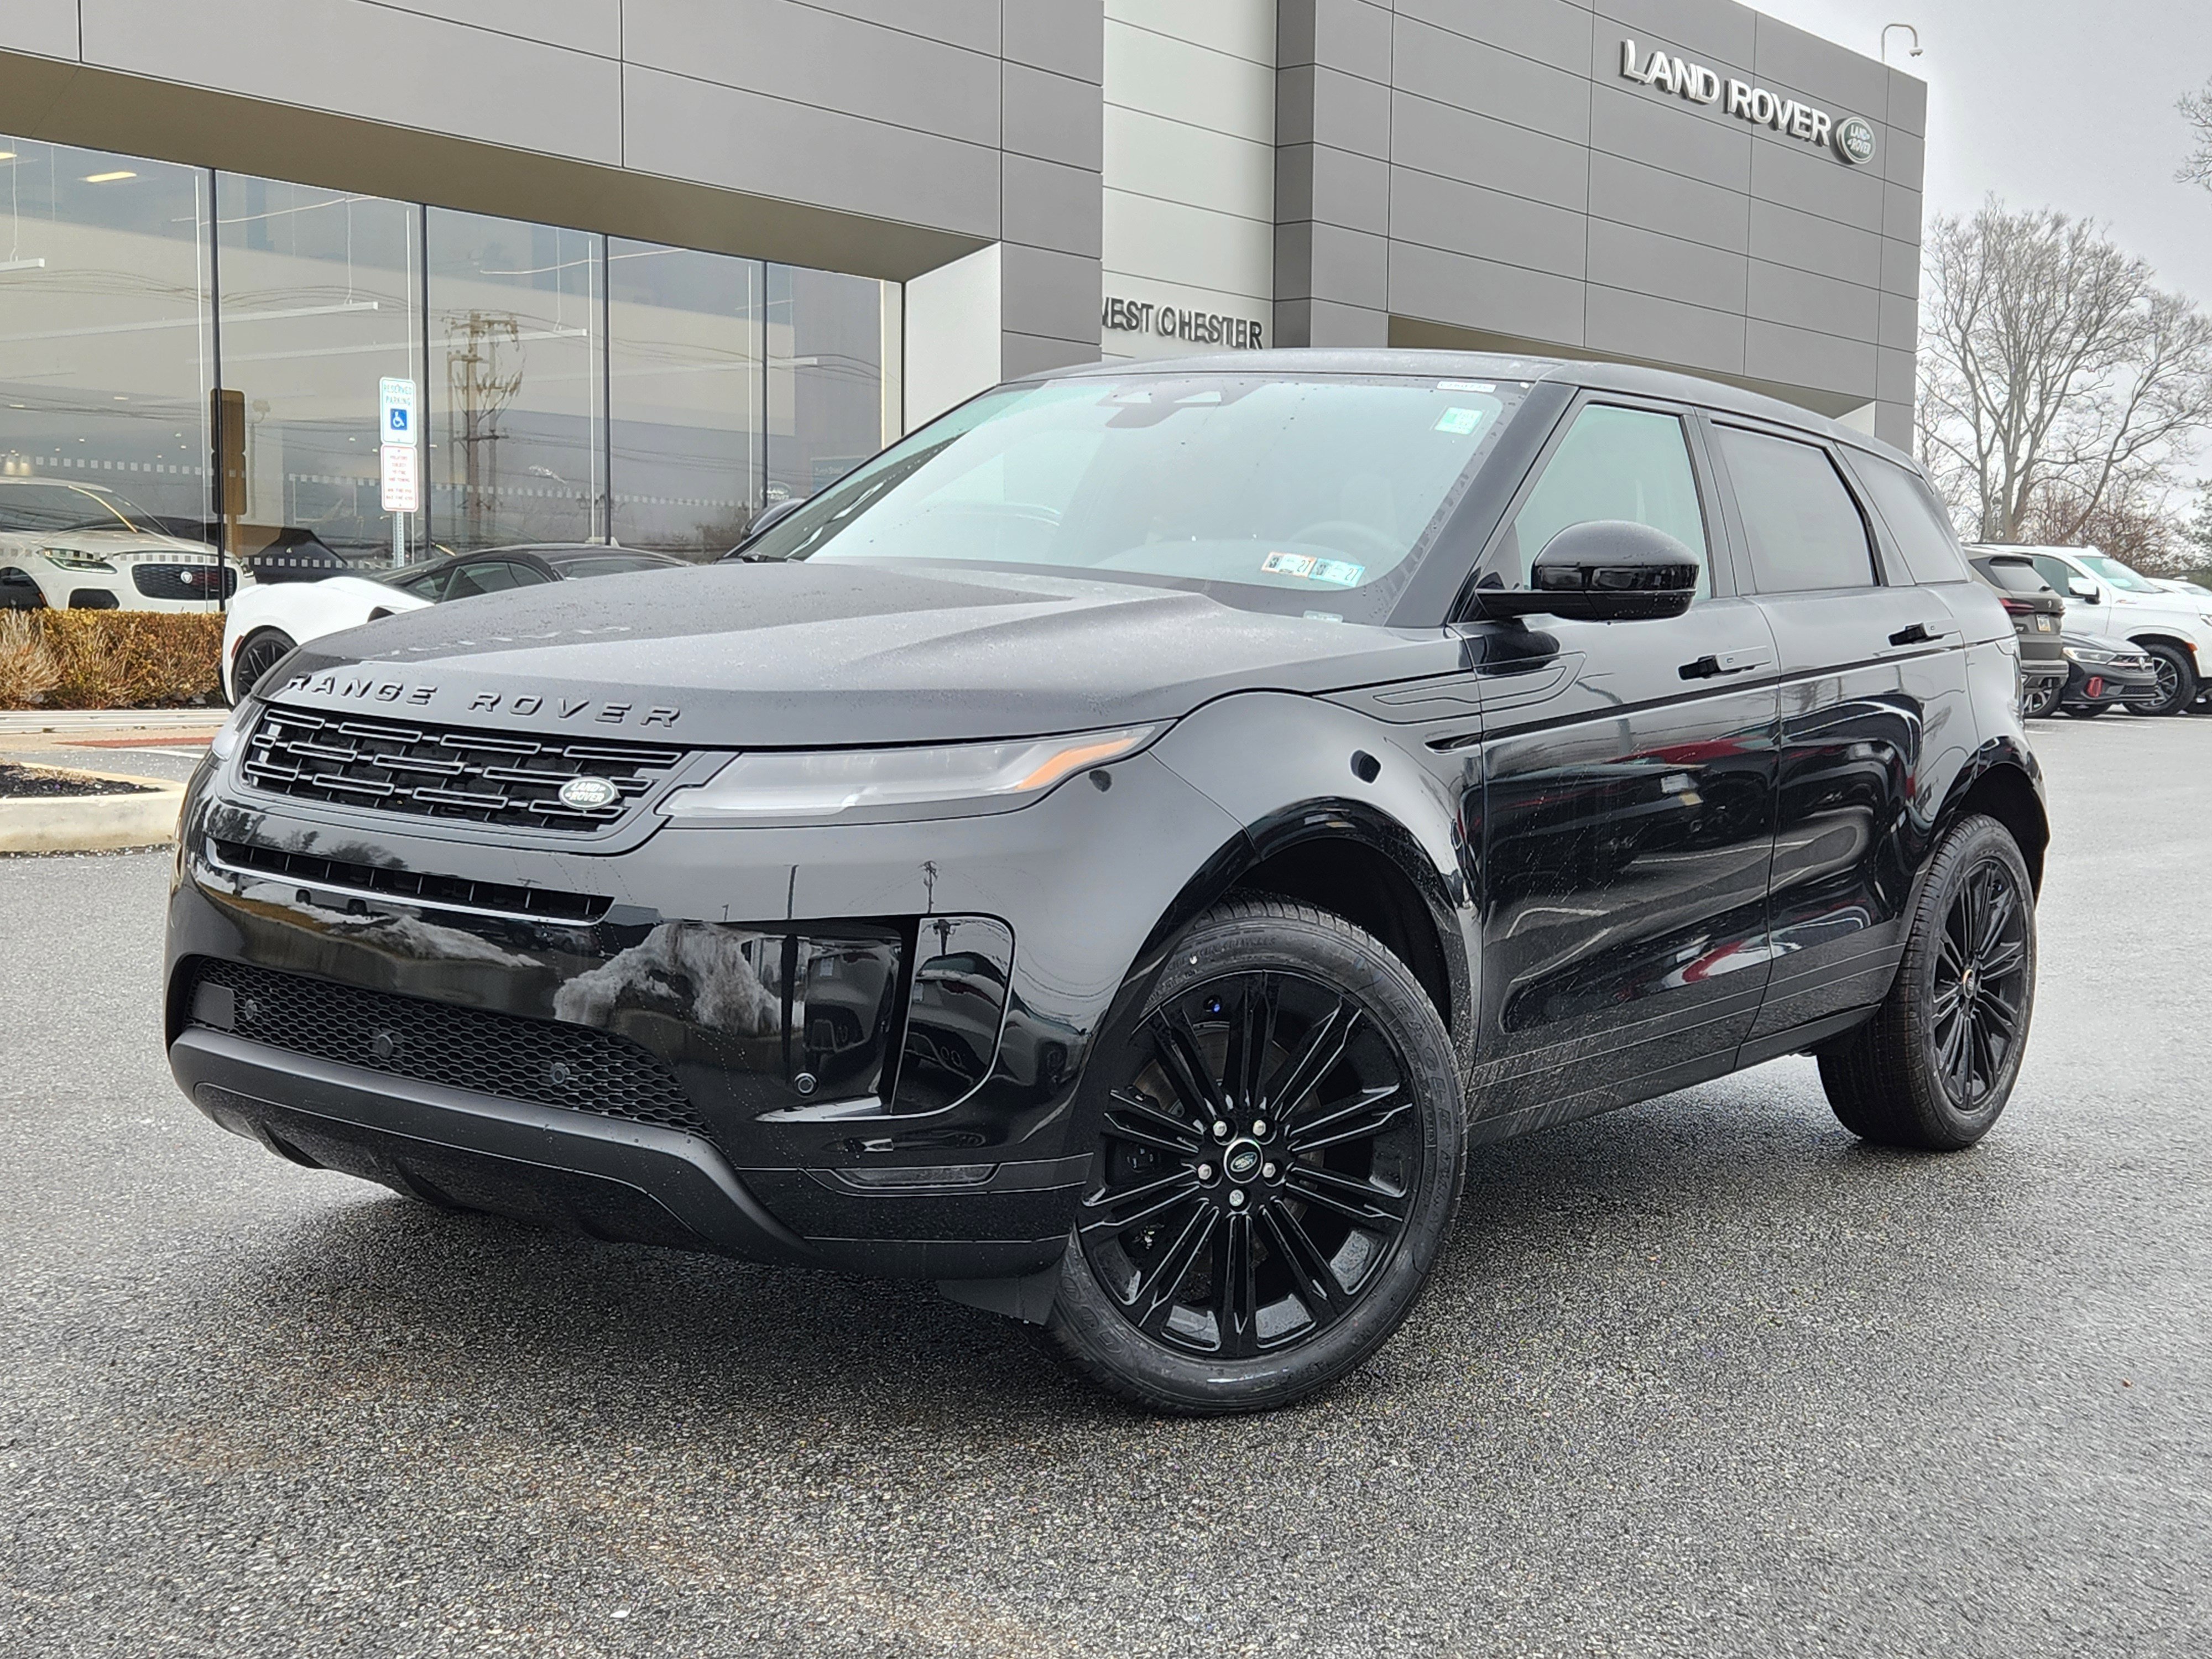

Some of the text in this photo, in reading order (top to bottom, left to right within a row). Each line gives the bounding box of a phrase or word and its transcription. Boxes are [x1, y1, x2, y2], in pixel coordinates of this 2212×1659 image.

[1623, 38, 1832, 147] LAND ROVER
[1850, 124, 1869, 140] LAND
[1850, 138, 1871, 155] ROVER
[1158, 306, 1263, 349] CHESTER
[385, 395, 411, 406] PARKING
[1297, 559, 1312, 573] 27
[1344, 567, 1359, 581] 27
[286, 674, 683, 728] RANGE ROVER
[571, 782, 601, 792] LAND
[568, 791, 605, 802] ROVER
